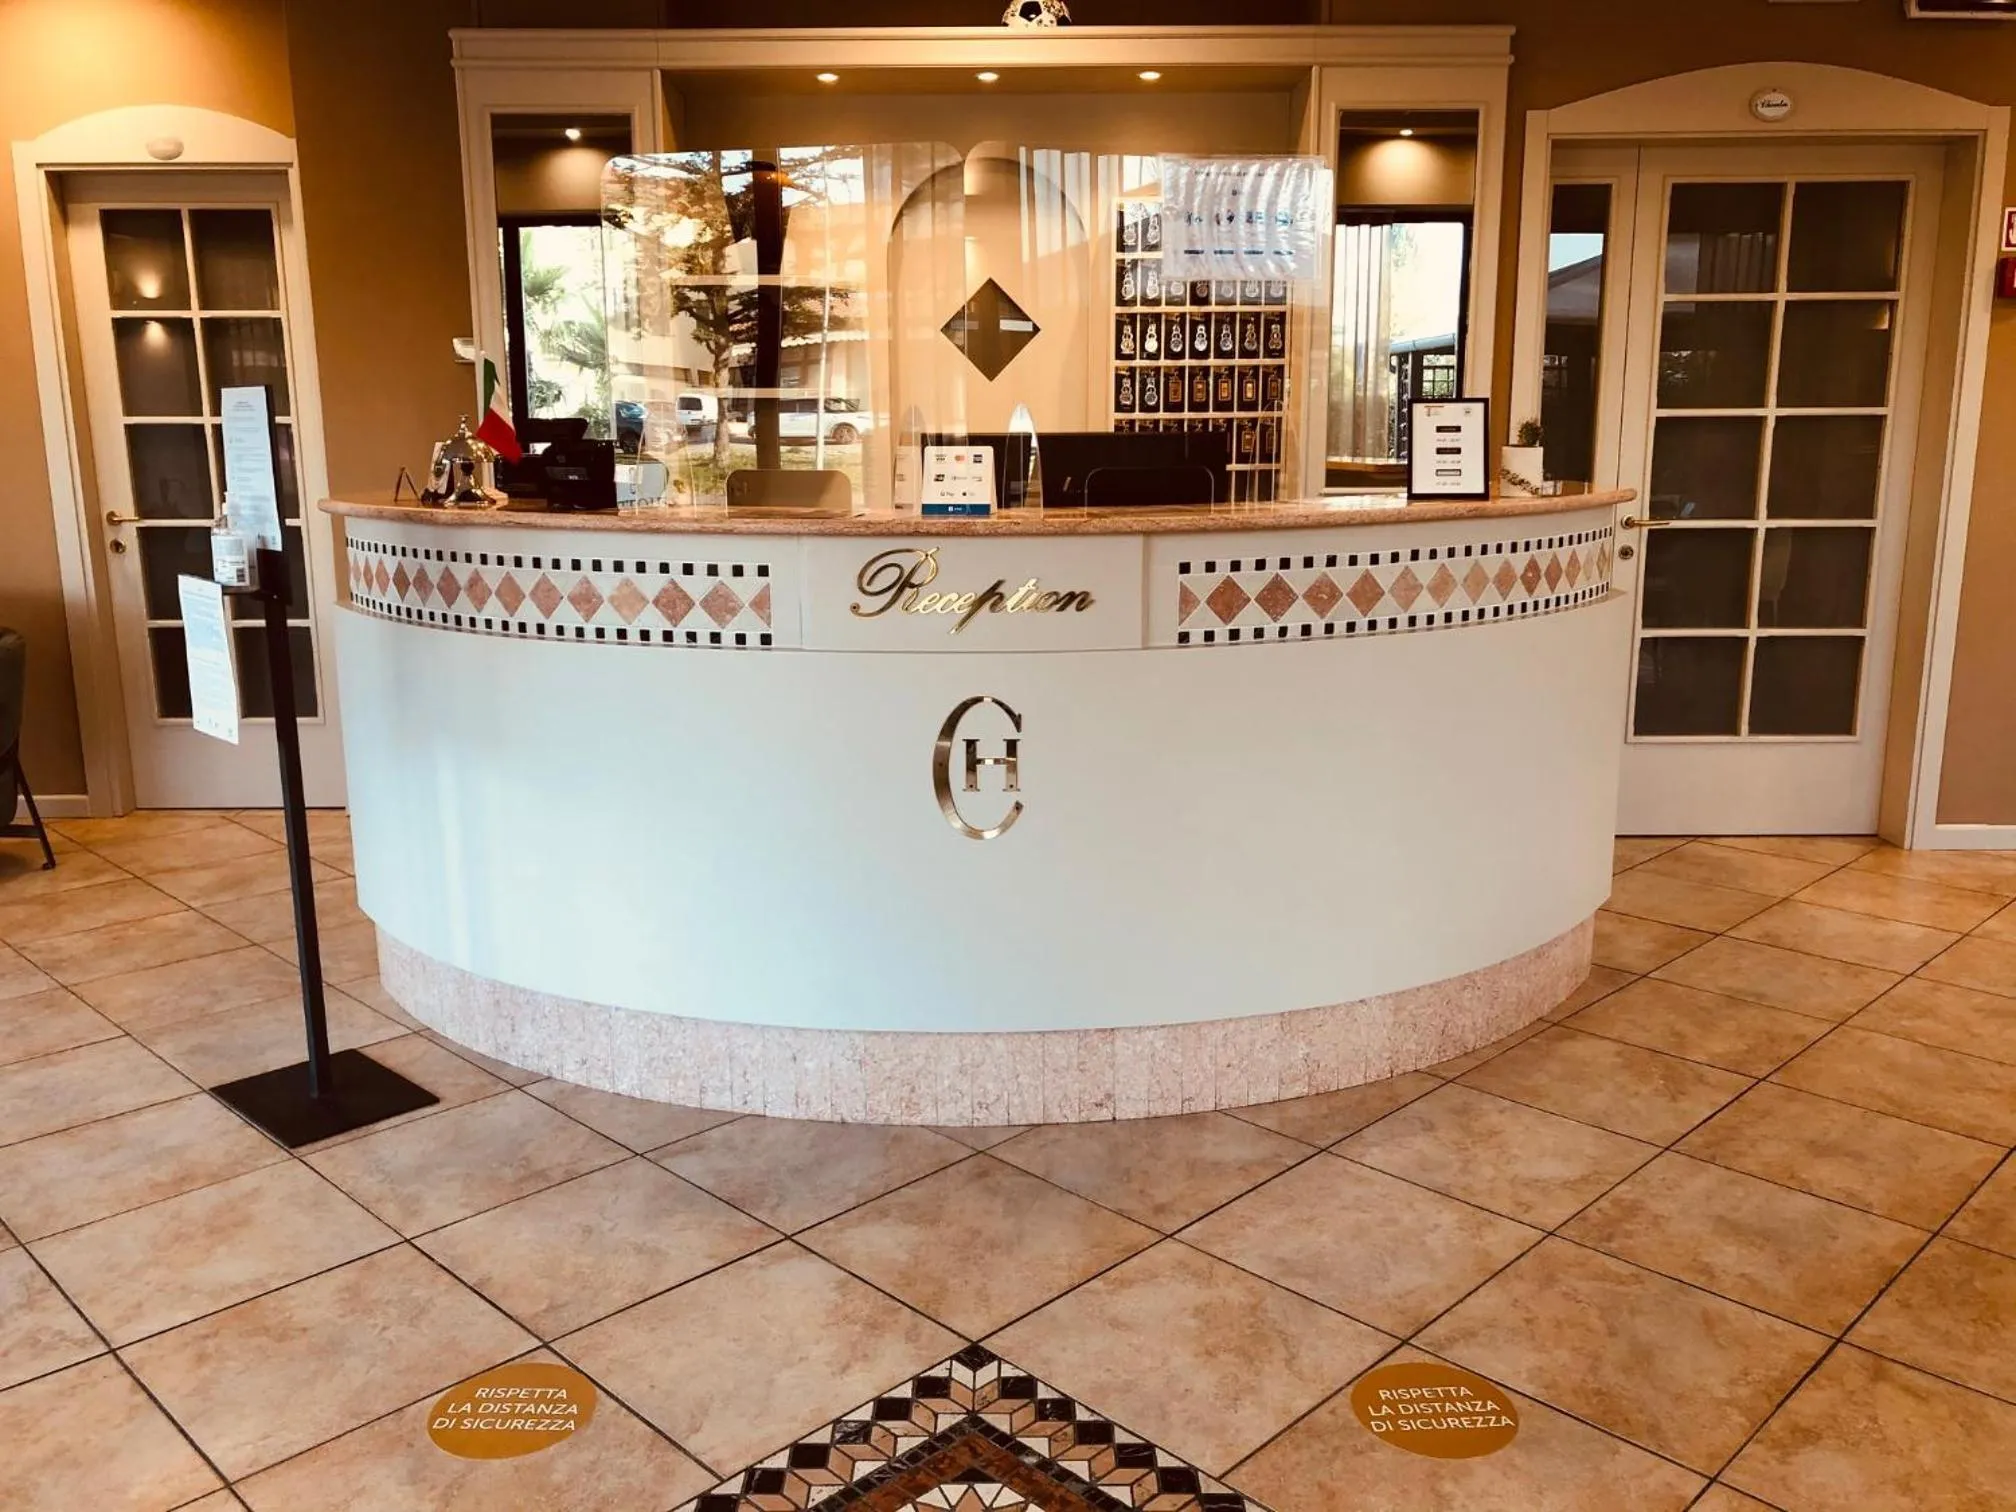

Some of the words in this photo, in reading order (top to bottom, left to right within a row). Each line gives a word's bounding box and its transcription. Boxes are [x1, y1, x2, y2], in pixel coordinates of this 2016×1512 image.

[850, 546, 1096, 635] Reception
[475, 1387, 567, 1399] RISPETTA
[1378, 1386, 1474, 1401] RISPETTA
[447, 1402, 472, 1414] LA
[478, 1402, 579, 1415] DISTANZA
[1368, 1405, 1396, 1417] LA
[1399, 1400, 1501, 1415] DISTANZA
[432, 1417, 457, 1430] DI
[460, 1418, 576, 1431] SICUREZZA
[1370, 1420, 1394, 1433] DI
[1397, 1415, 1516, 1432] SICUREZZA
